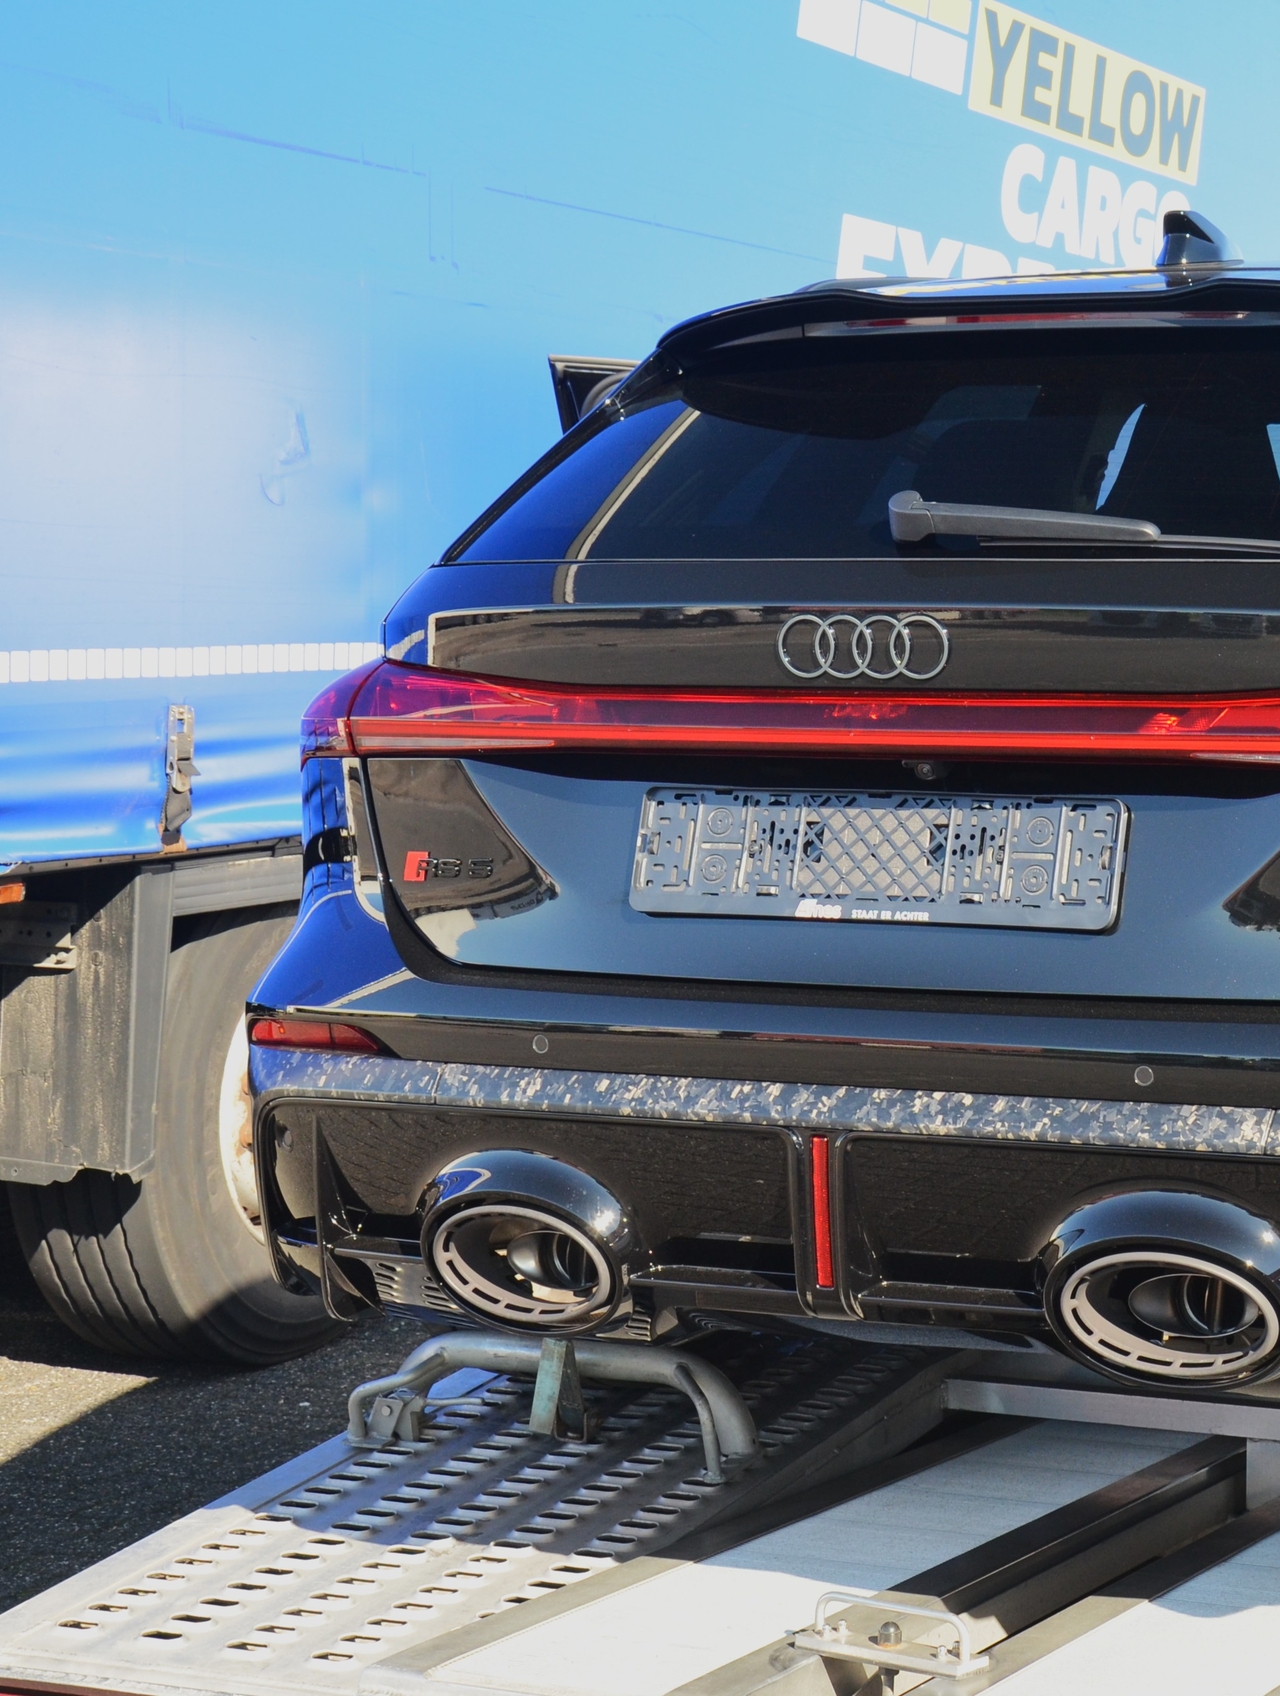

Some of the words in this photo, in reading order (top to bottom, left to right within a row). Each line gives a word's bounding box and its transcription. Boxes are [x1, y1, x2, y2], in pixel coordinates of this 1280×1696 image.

[984, 7, 1201, 174] YELLOW
[851, 909, 878, 919] STAAT
[881, 910, 892, 920] ER
[894, 911, 929, 921] ACHTER
